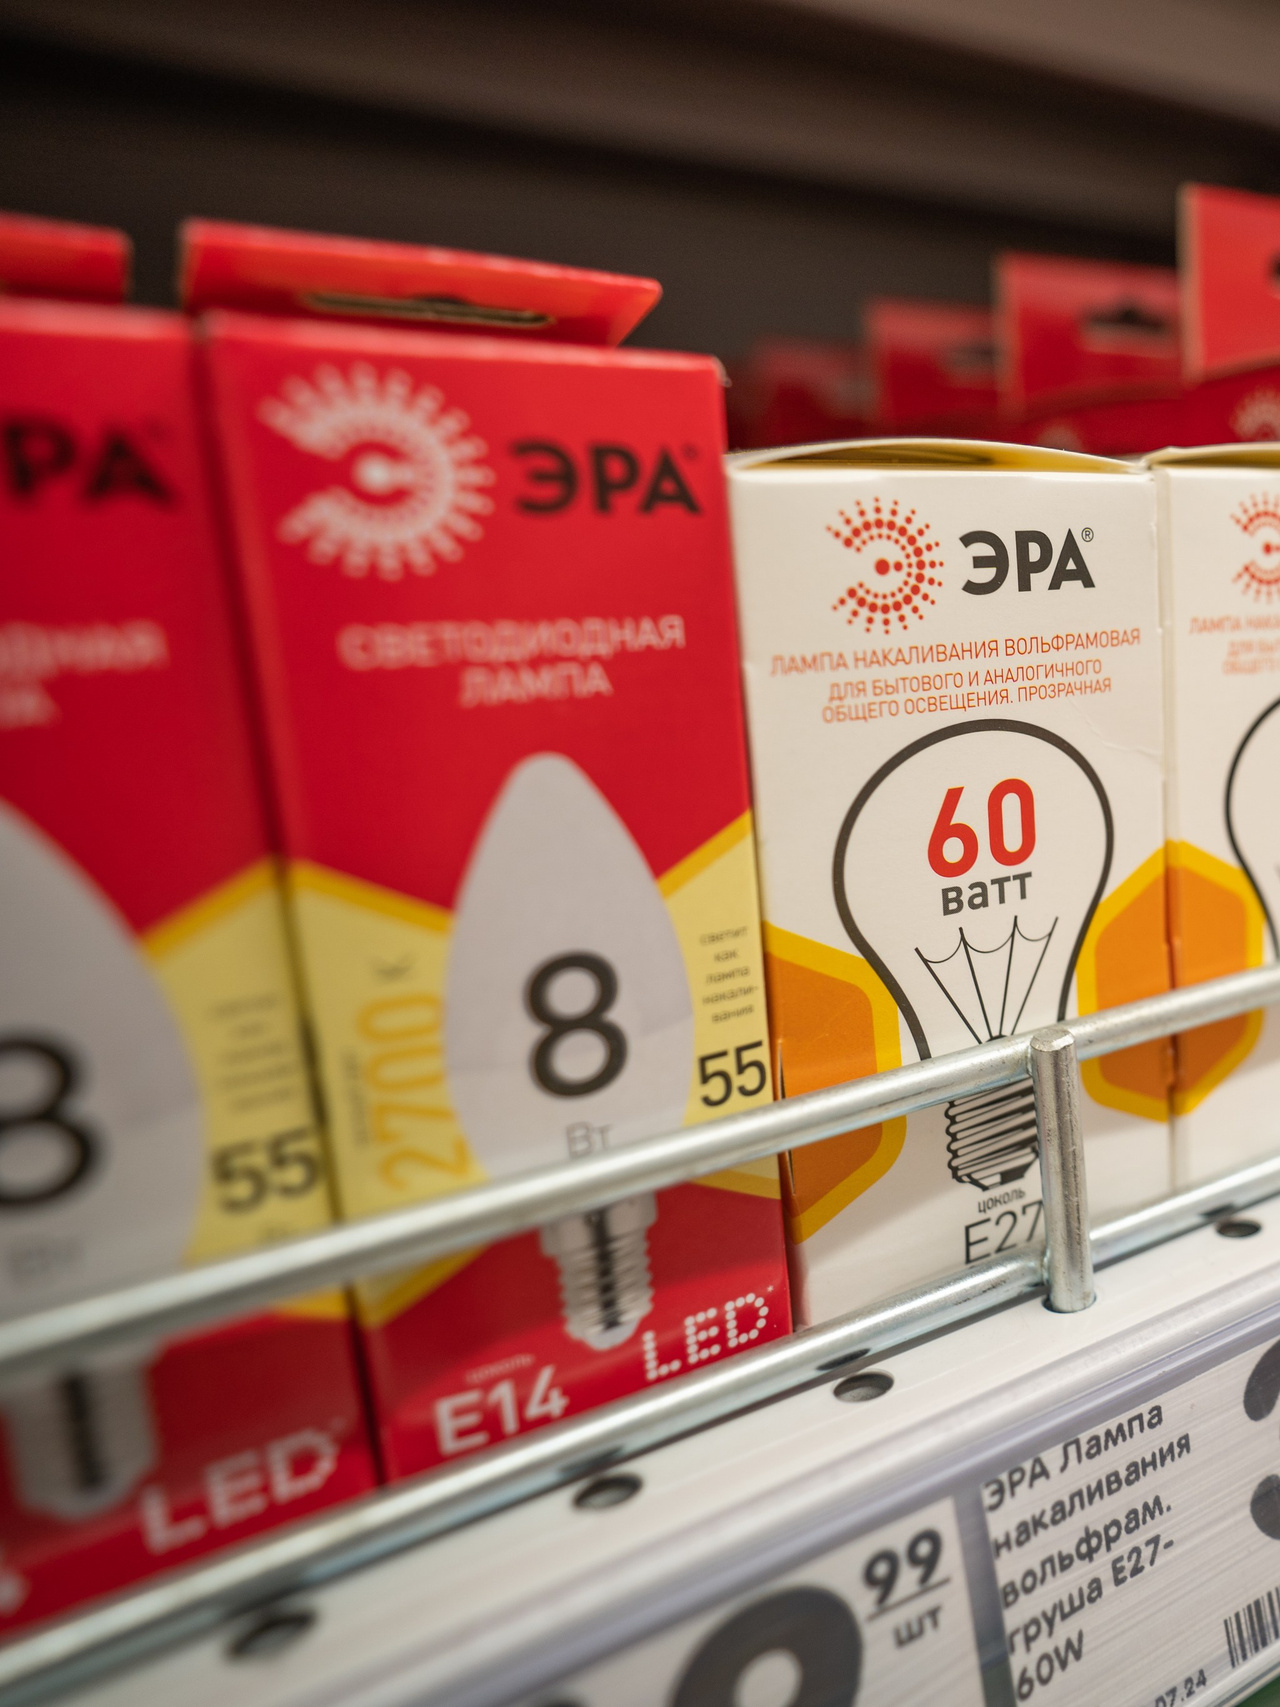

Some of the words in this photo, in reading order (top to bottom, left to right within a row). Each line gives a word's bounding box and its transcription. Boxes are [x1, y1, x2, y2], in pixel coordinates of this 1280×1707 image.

[4, 418, 178, 504] РА
[510, 440, 702, 514] ЭРА
[769, 651, 849, 678] ЛАМПА
[853, 639, 999, 669] НАКАЛИВАНИЯ
[1004, 627, 1141, 657] ВОЛЬФРАМОВАЯ
[828, 680, 867, 704] ДЛЯ
[872, 672, 964, 697] БЫТОВОГО
[968, 670, 979, 687] И
[983, 659, 1103, 686] АНАЛОГИЧНОГО
[822, 699, 900, 724] ОБЩЕГО
[904, 688, 1013, 715] ОСВЕЩЕНИЯ.
[1018, 677, 1112, 703] ПРОЗРАЧНАЯ
[927, 777, 1037, 878] 60
[941, 871, 1033, 917] ватт
[699, 925, 749, 946] светит
[705, 965, 750, 985] лампа
[522, 948, 628, 1098] 8
[711, 1004, 755, 1024] вания
[698, 1040, 766, 1107] 55
[211, 1125, 320, 1216] 55
[977, 1187, 1026, 1214] цоколь
[965, 1199, 1044, 1265] E27
[434, 1364, 570, 1456] E14
[983, 1456, 1051, 1513] ЭРА
[1060, 1403, 1164, 1473] Лампа
[992, 1431, 1192, 1560] накаливания
[862, 1527, 943, 1606] 99
[1002, 1494, 1173, 1610] вольфрам.
[893, 1605, 943, 1650] шт
[1007, 1576, 1104, 1656] груша
[1110, 1532, 1175, 1588] E27-
[1016, 1628, 1085, 1702] 60W
